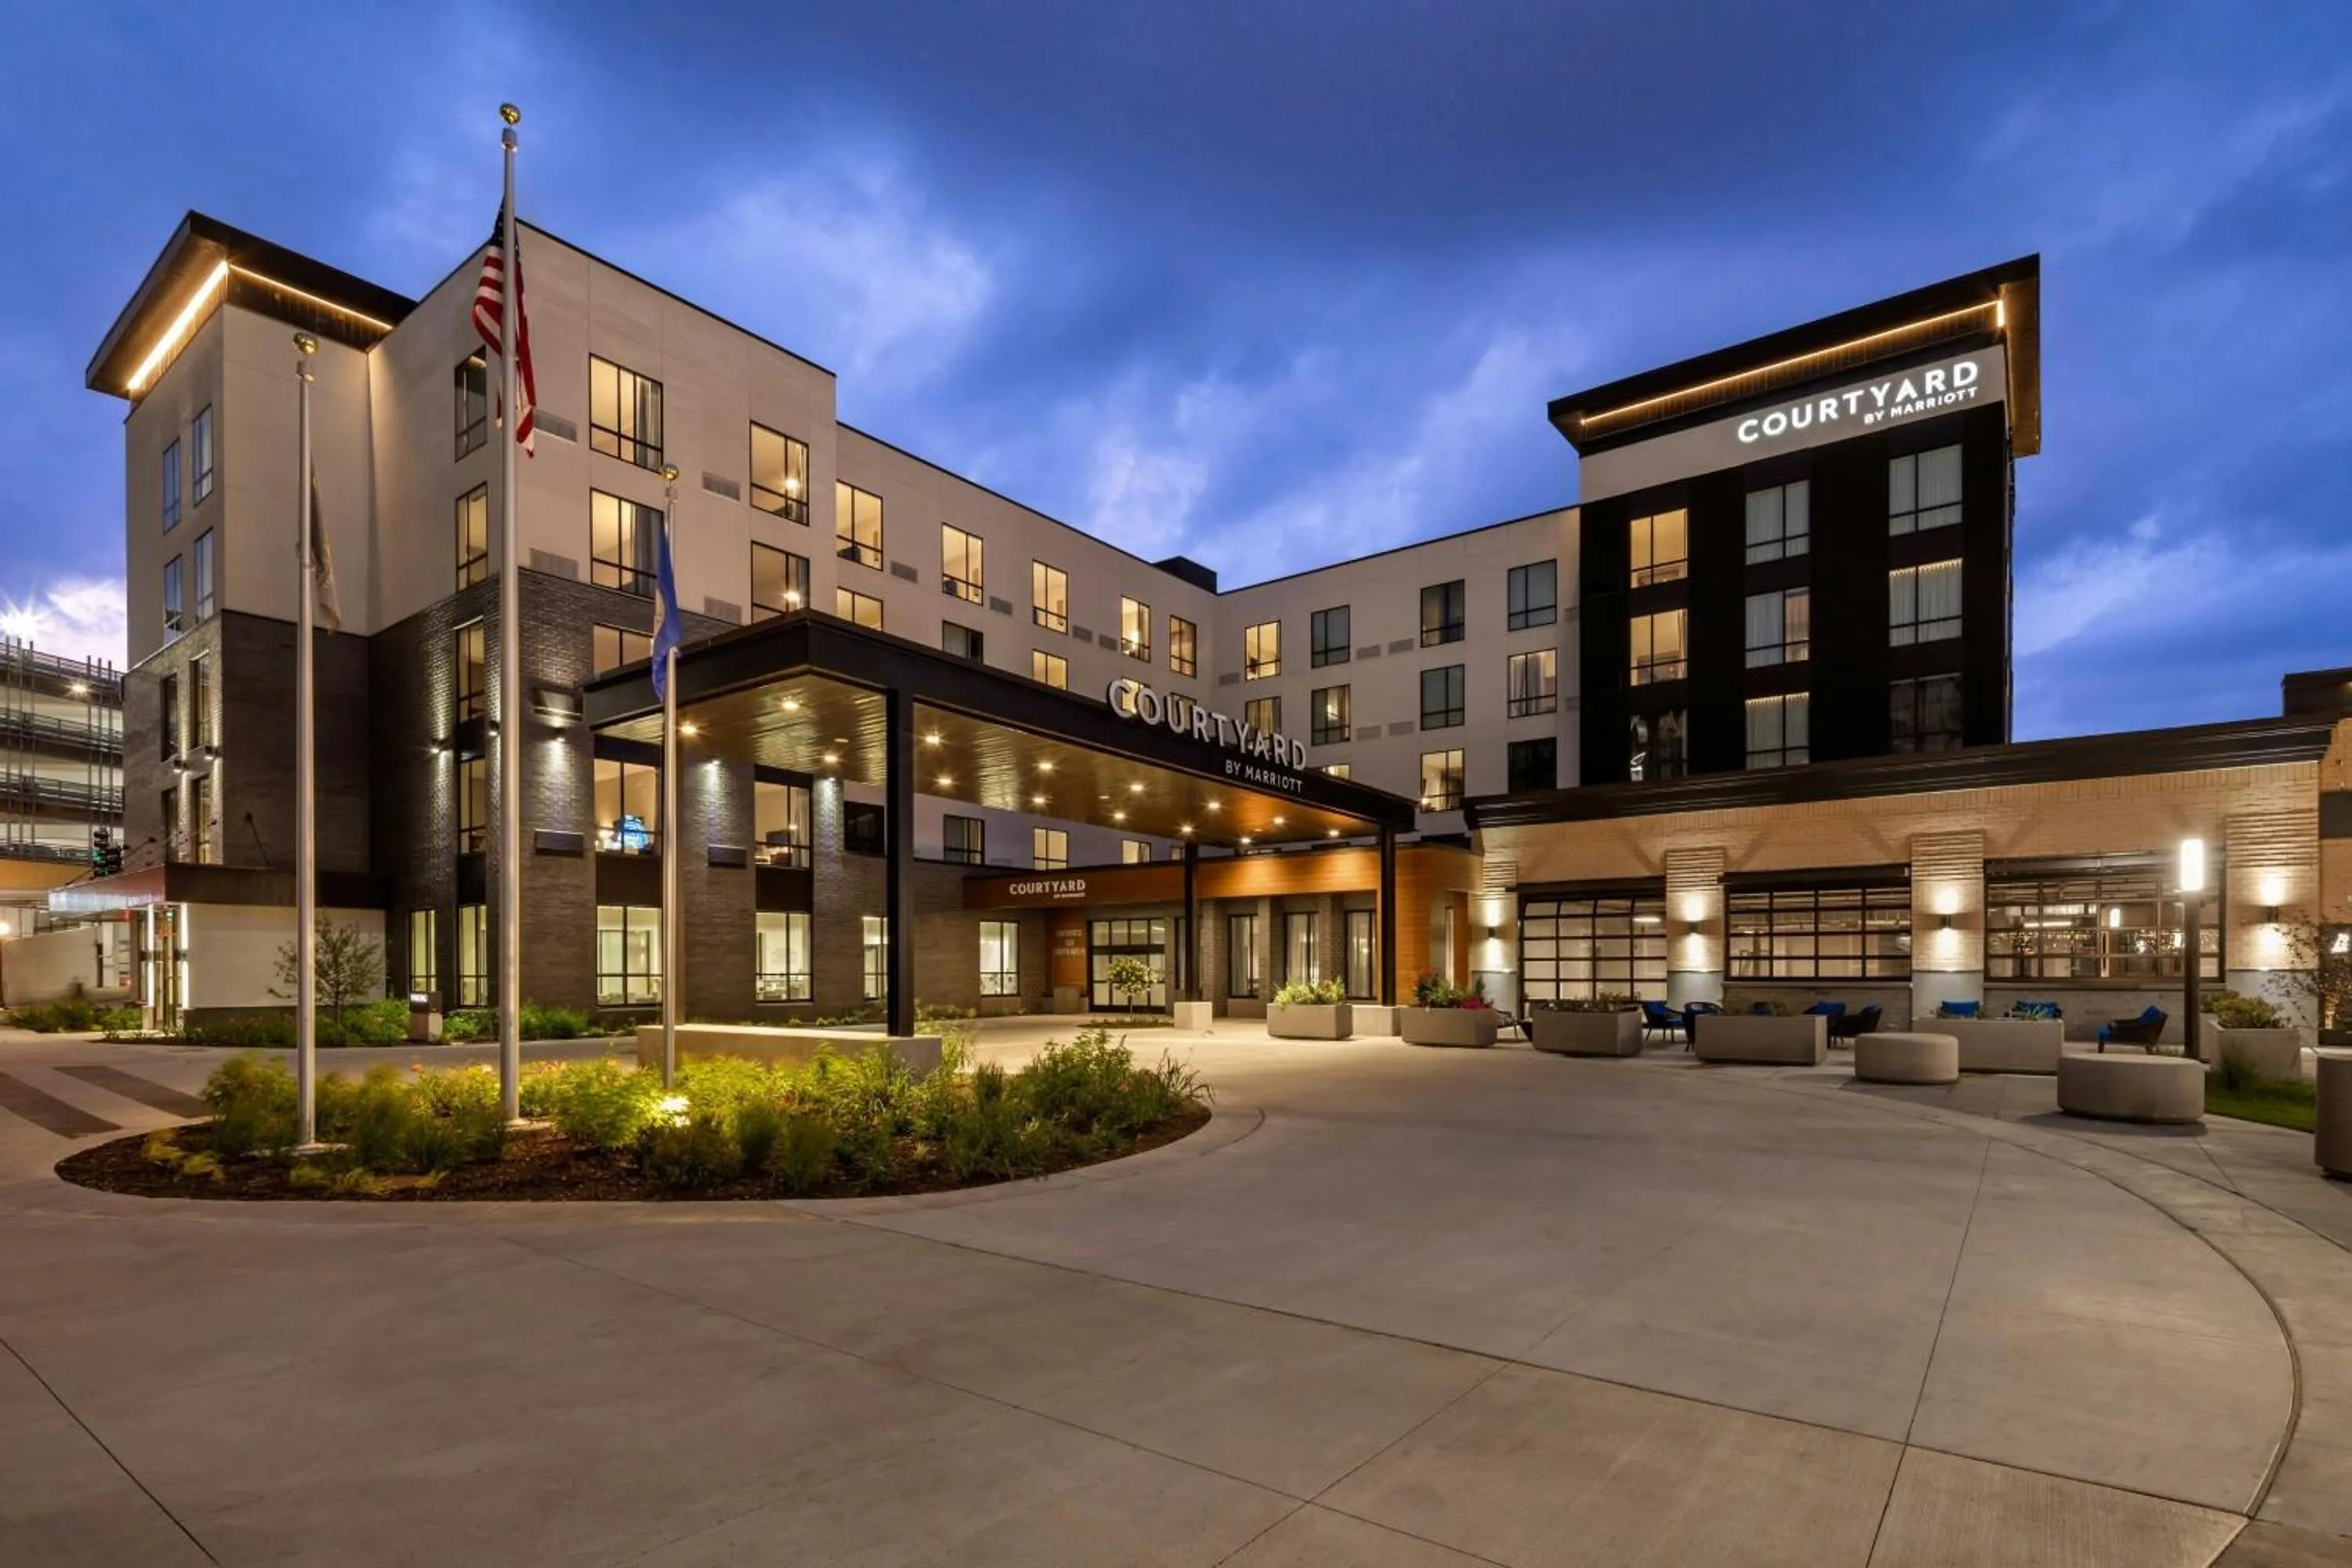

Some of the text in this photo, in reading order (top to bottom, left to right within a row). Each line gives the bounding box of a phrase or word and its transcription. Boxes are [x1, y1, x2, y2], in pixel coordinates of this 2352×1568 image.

[1738, 361, 1979, 442] COURTYARD
[1864, 387, 1978, 425] BY MARRIOTT
[1108, 678, 1307, 771] COURTYARD
[1225, 759, 1302, 793] BY MARRIOTT
[1009, 879, 1086, 895] COURTYARD
